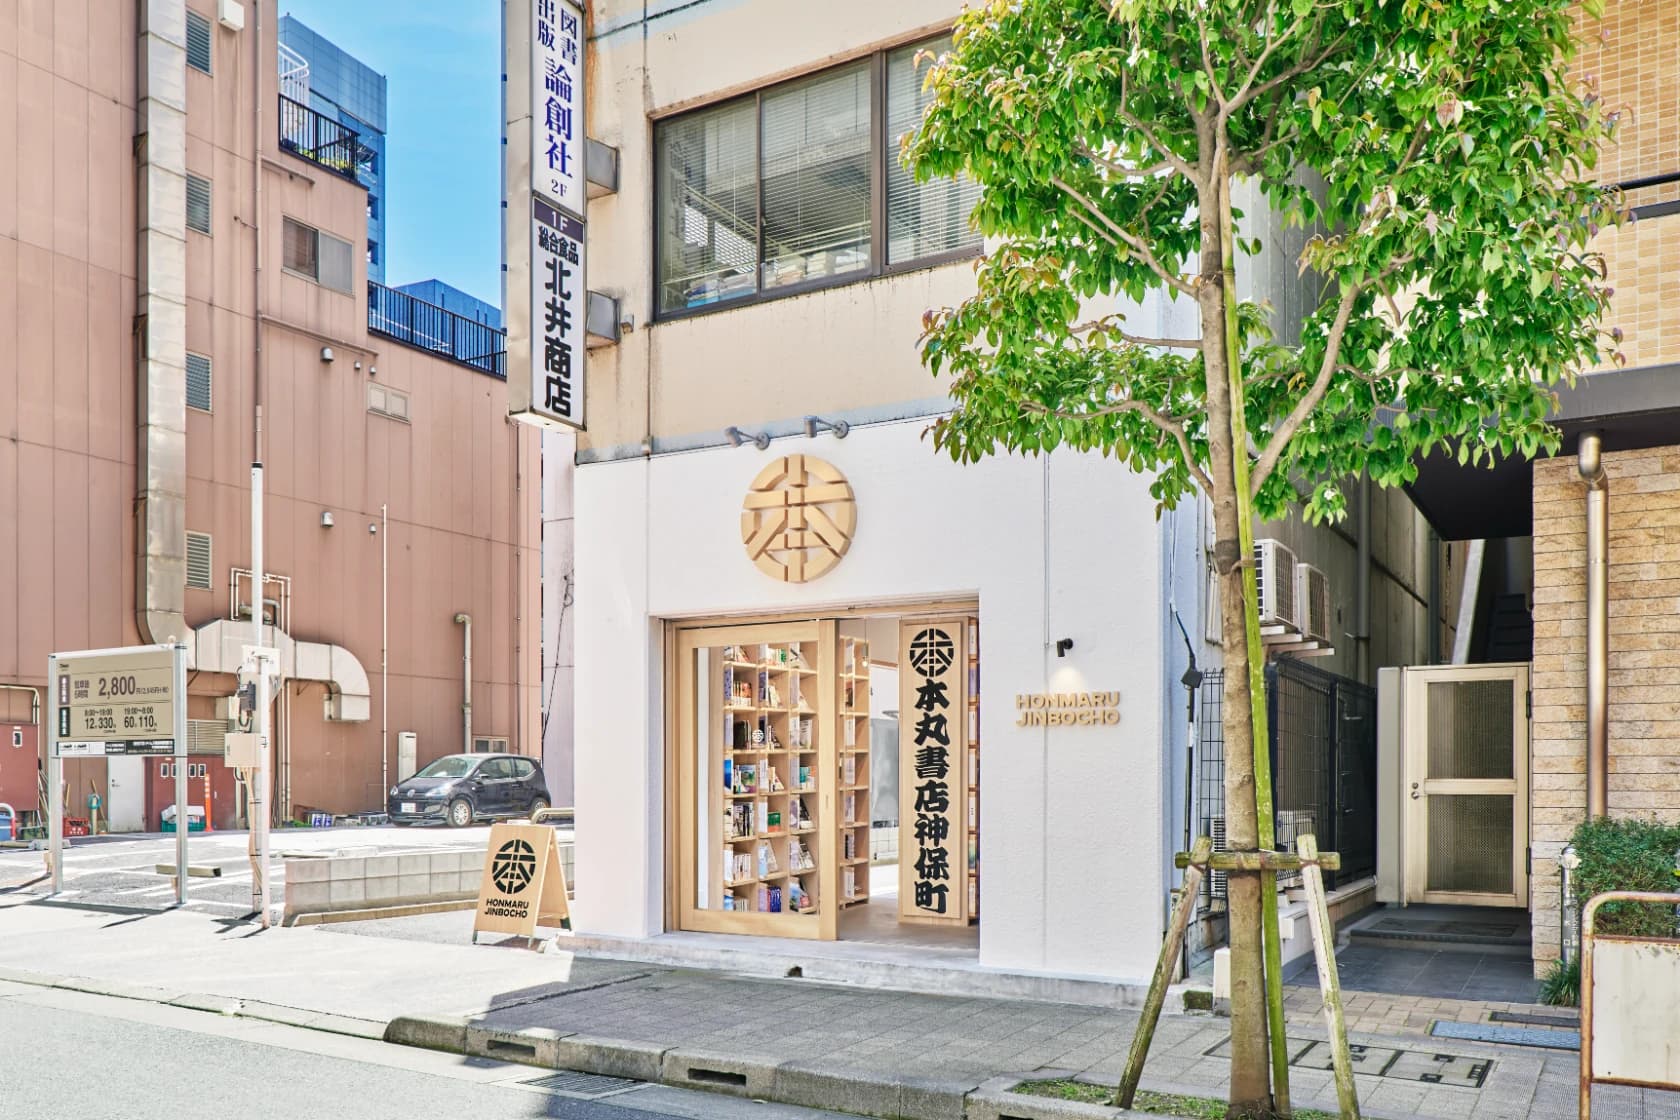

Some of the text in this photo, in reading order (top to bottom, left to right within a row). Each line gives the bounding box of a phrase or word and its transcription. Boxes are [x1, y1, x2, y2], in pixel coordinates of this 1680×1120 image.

[544, 57, 573, 178] 論創社
[551, 178, 568, 197] 2F
[551, 211, 569, 231] 1F
[538, 225, 579, 266] 総合食品
[544, 257, 572, 418] 北井商店
[98, 675, 136, 699] 2,800
[1016, 691, 1121, 709] HONMARU
[1016, 709, 1121, 727] JINBOCHO
[913, 678, 951, 914] 本丸書店神保町
[484, 907, 528, 919] JINBOCHO
[486, 898, 529, 909] HONMARU
